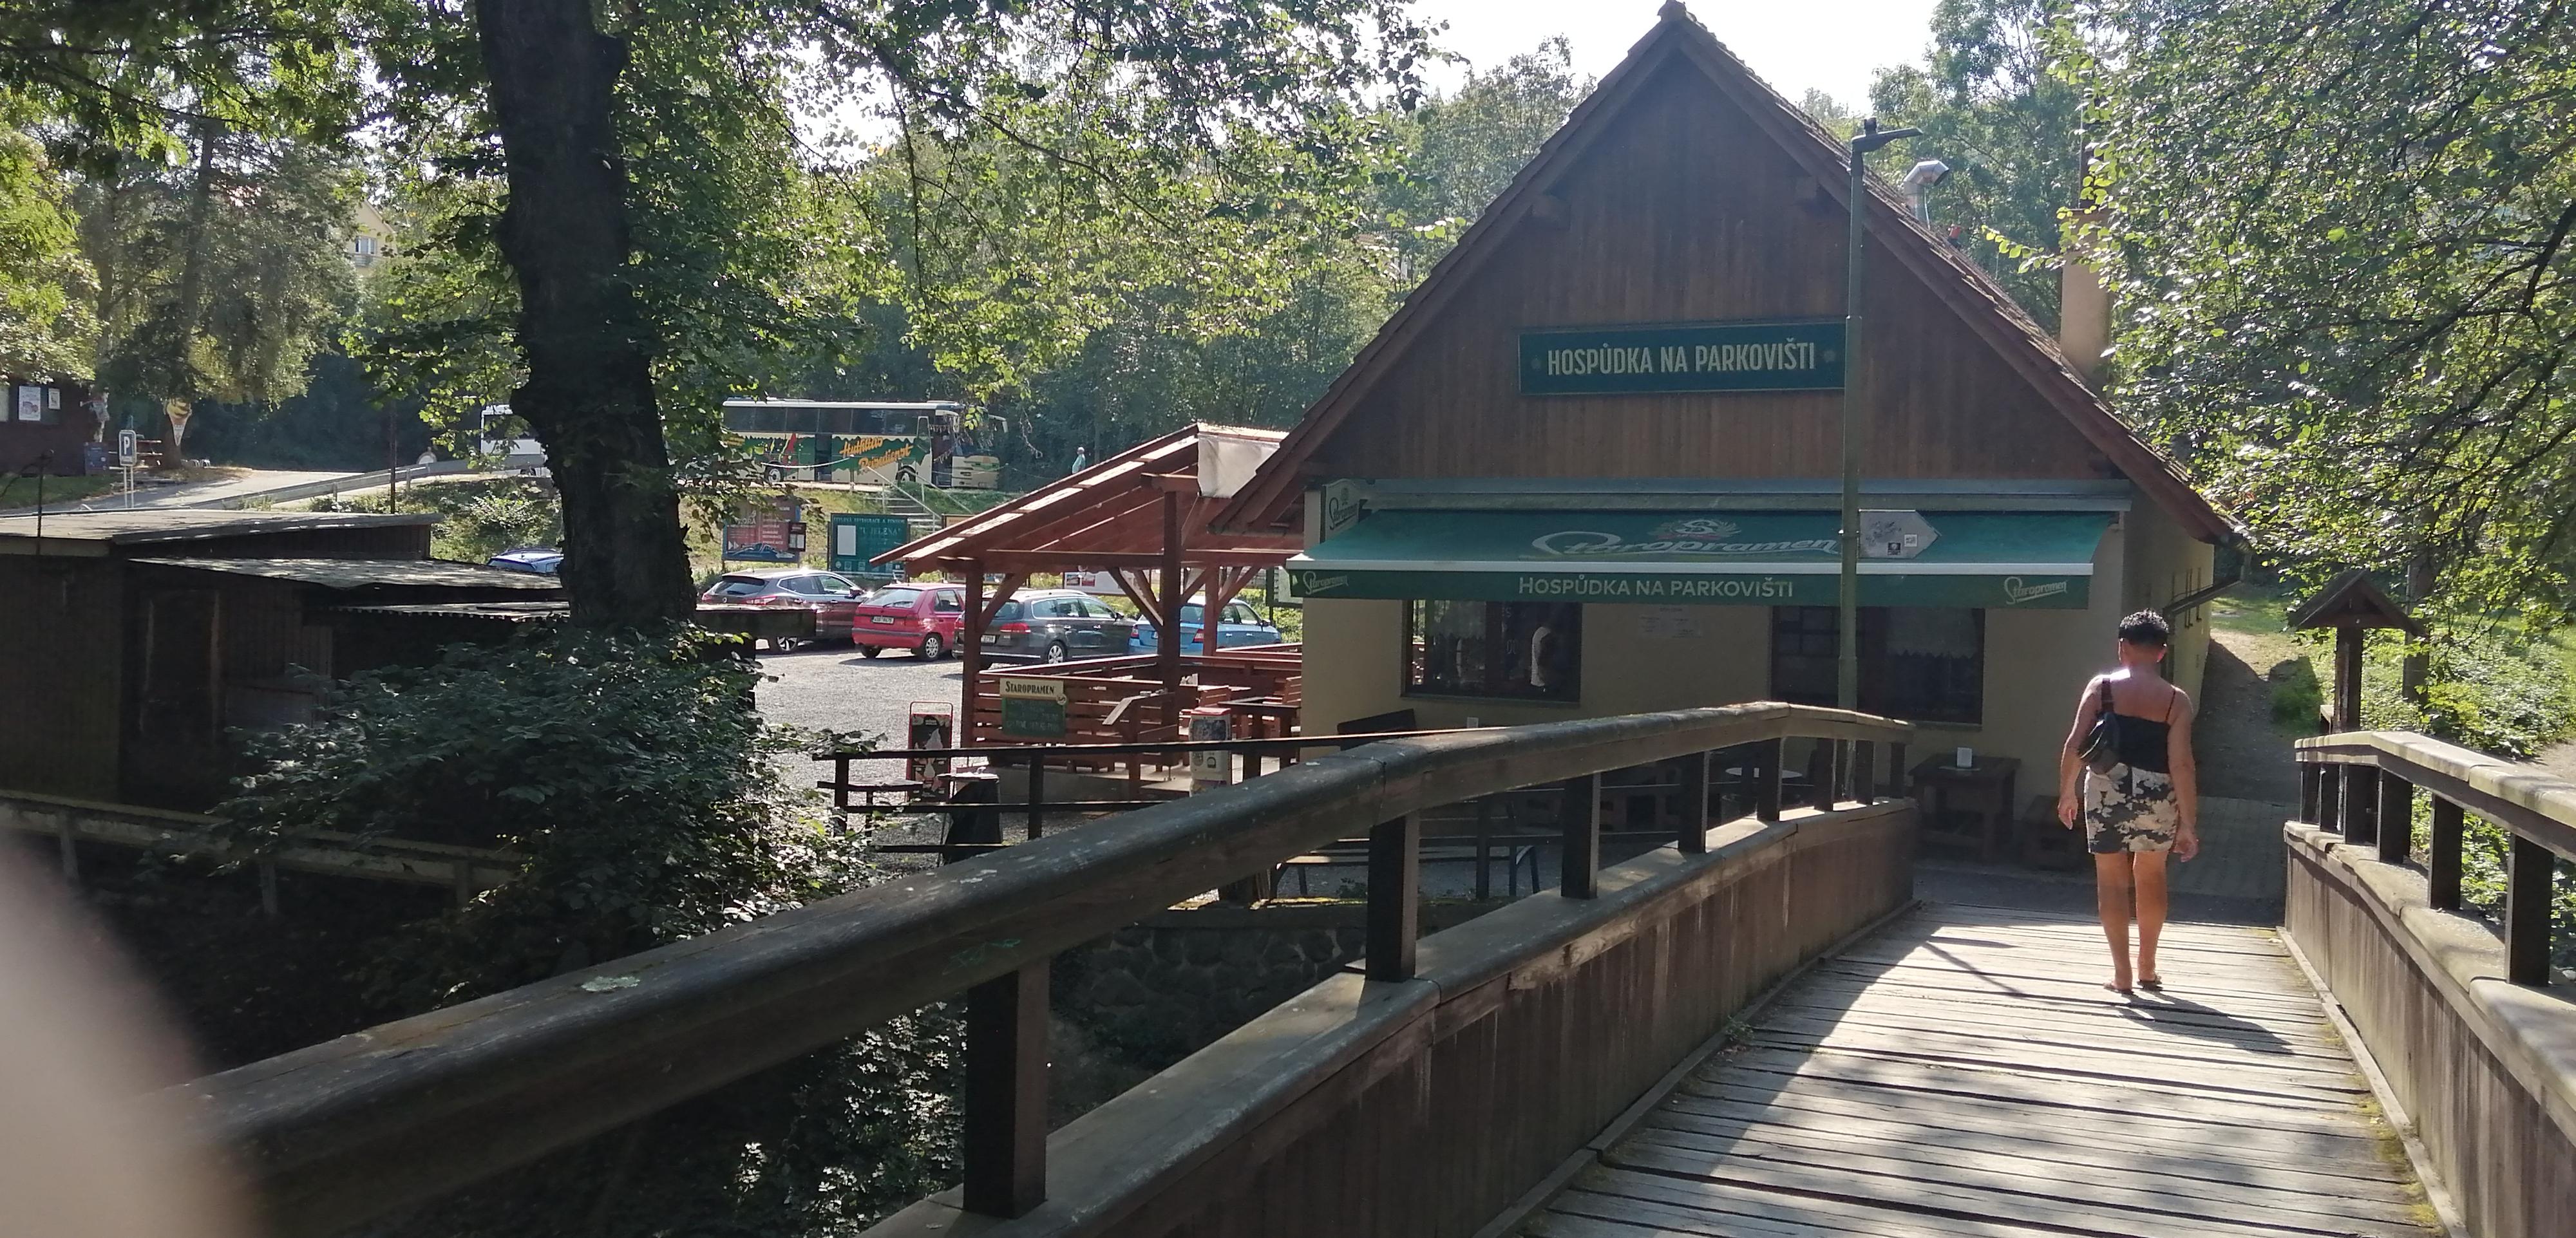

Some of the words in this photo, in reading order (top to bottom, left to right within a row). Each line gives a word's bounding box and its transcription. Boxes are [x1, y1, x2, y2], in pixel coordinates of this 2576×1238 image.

[1548, 342, 1653, 376] HOSPŮDKA
[1660, 346, 1688, 373] NA
[1695, 337, 1815, 371] PARKOVIŠTI
[123, 436, 130, 455] P
[1519, 574, 1630, 596] HOSPŮDKA
[1636, 580, 1665, 597] NA
[1671, 577, 1794, 598] PARKOVIŠTI
[2004, 576, 2068, 605] Staropramen
[1005, 680, 1054, 695] STAROPRAMEN
